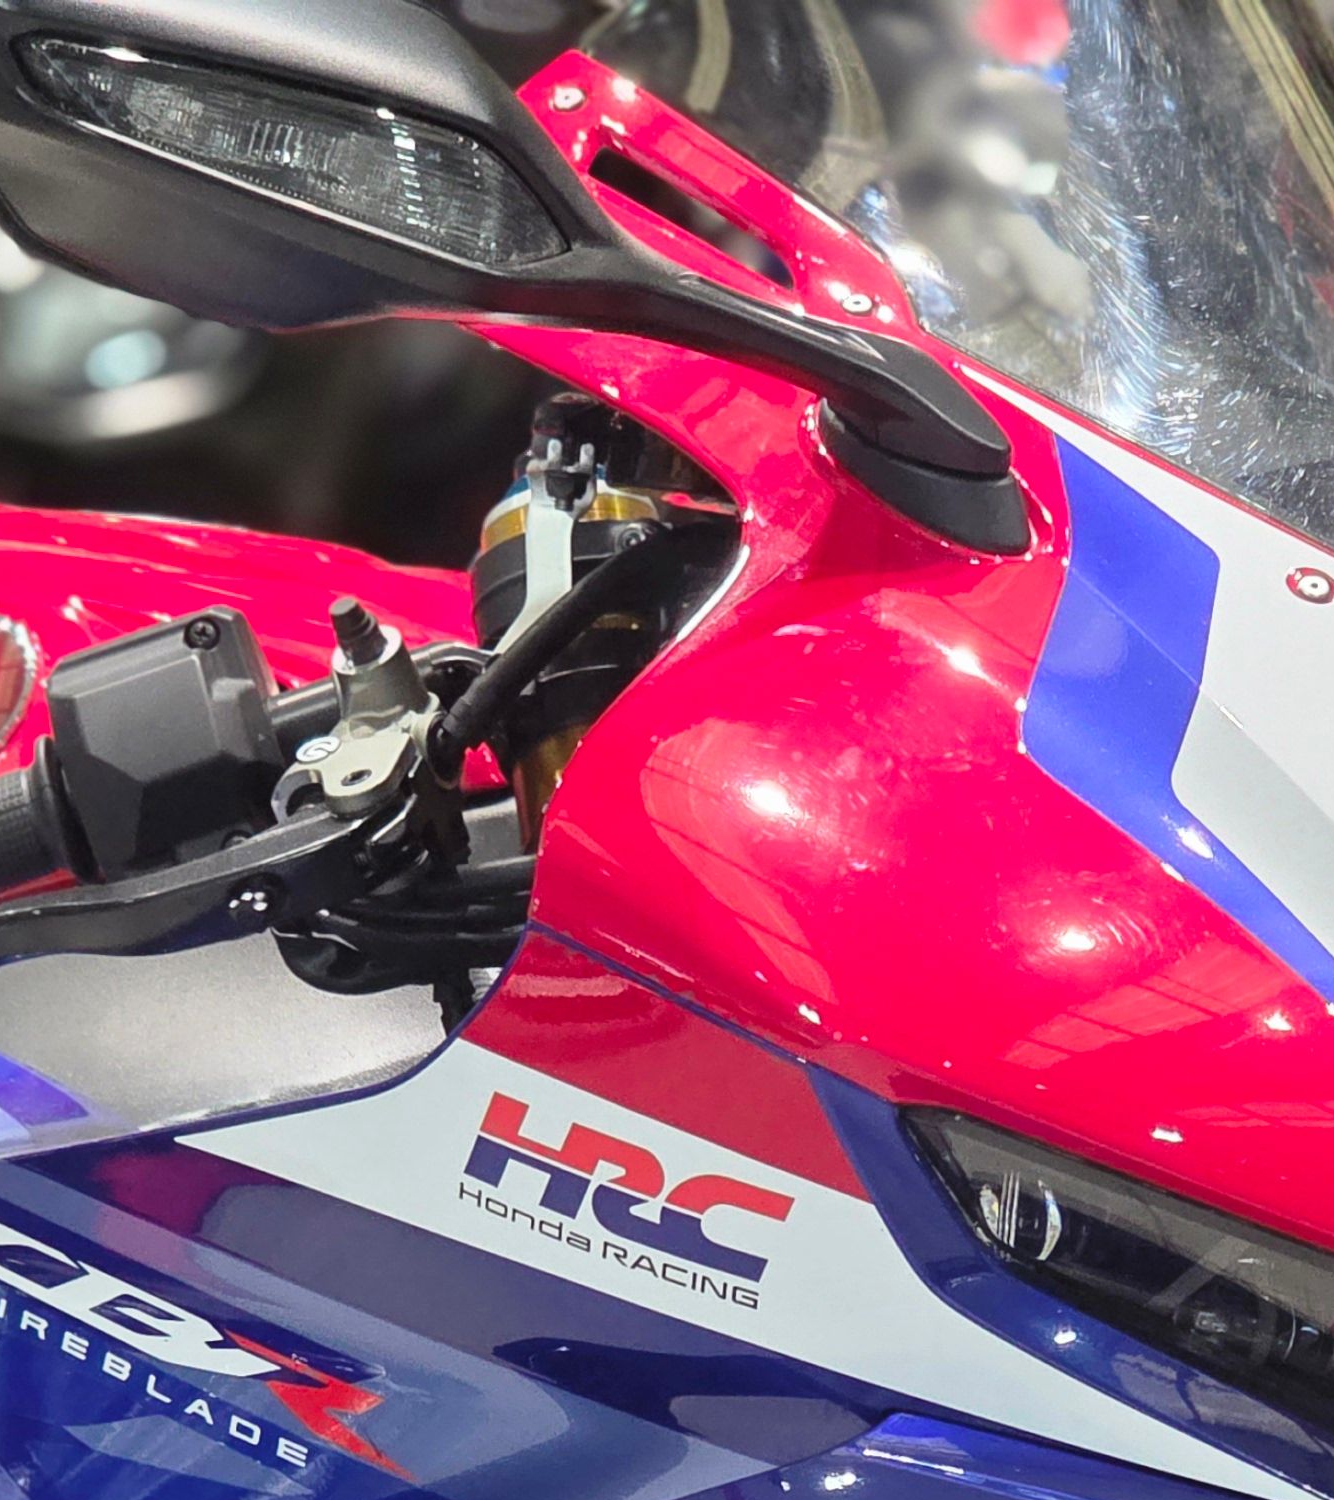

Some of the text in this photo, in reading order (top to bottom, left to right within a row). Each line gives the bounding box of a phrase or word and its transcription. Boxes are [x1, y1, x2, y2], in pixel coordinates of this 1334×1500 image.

[458, 1182, 760, 1310] Honda RACING
[463, 1091, 795, 1283] HRC
